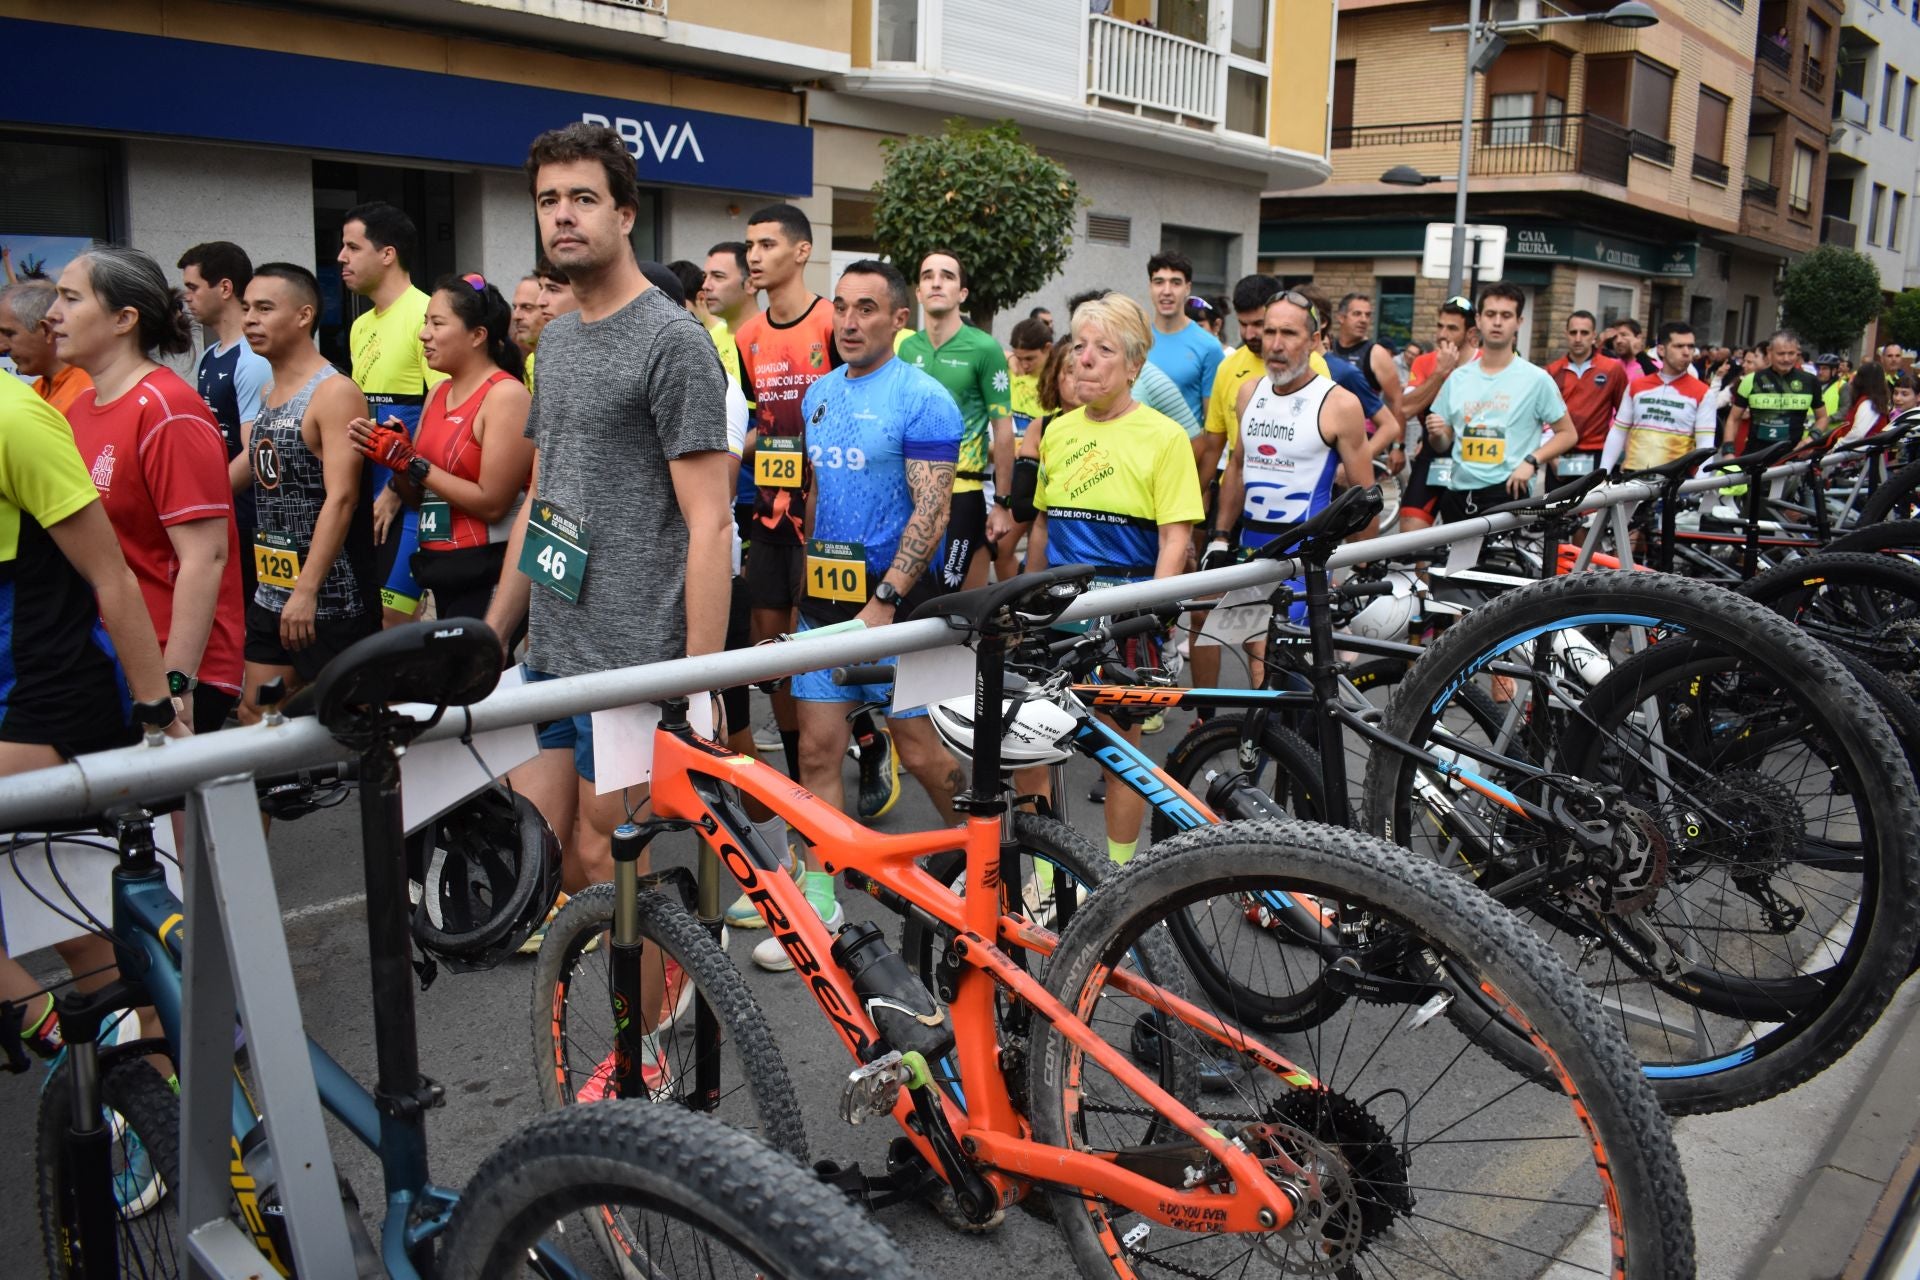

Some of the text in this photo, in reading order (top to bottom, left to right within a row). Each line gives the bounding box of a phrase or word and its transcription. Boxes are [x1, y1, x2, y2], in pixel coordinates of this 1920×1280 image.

[1518, 231, 1546, 243] CAJA
[1518, 242, 1557, 255] RURAL
[1247, 417, 1295, 442] Bartolomé
[1768, 428, 1778, 438] 2
[808, 445, 866, 471] 239
[1065, 440, 1098, 468] RINCON
[1466, 442, 1498, 457] 114
[761, 459, 796, 479] 128
[1567, 462, 1582, 472] 11
[1070, 466, 1115, 501] ATLETISMO
[1063, 510, 1072, 518] DE
[1073, 511, 1092, 520] SOTO
[1096, 513, 1106, 521] LA
[260, 554, 293, 579] 129
[537, 545, 567, 580] 46
[945, 539, 960, 570] Ramiro
[955, 539, 969, 572] Arnedo
[814, 566, 857, 592] 110
[1092, 690, 1184, 707] 229
[720, 843, 870, 1064] ORBEA
[1182, 1205, 1201, 1219] YOU
[1202, 1208, 1227, 1221] EVEN
